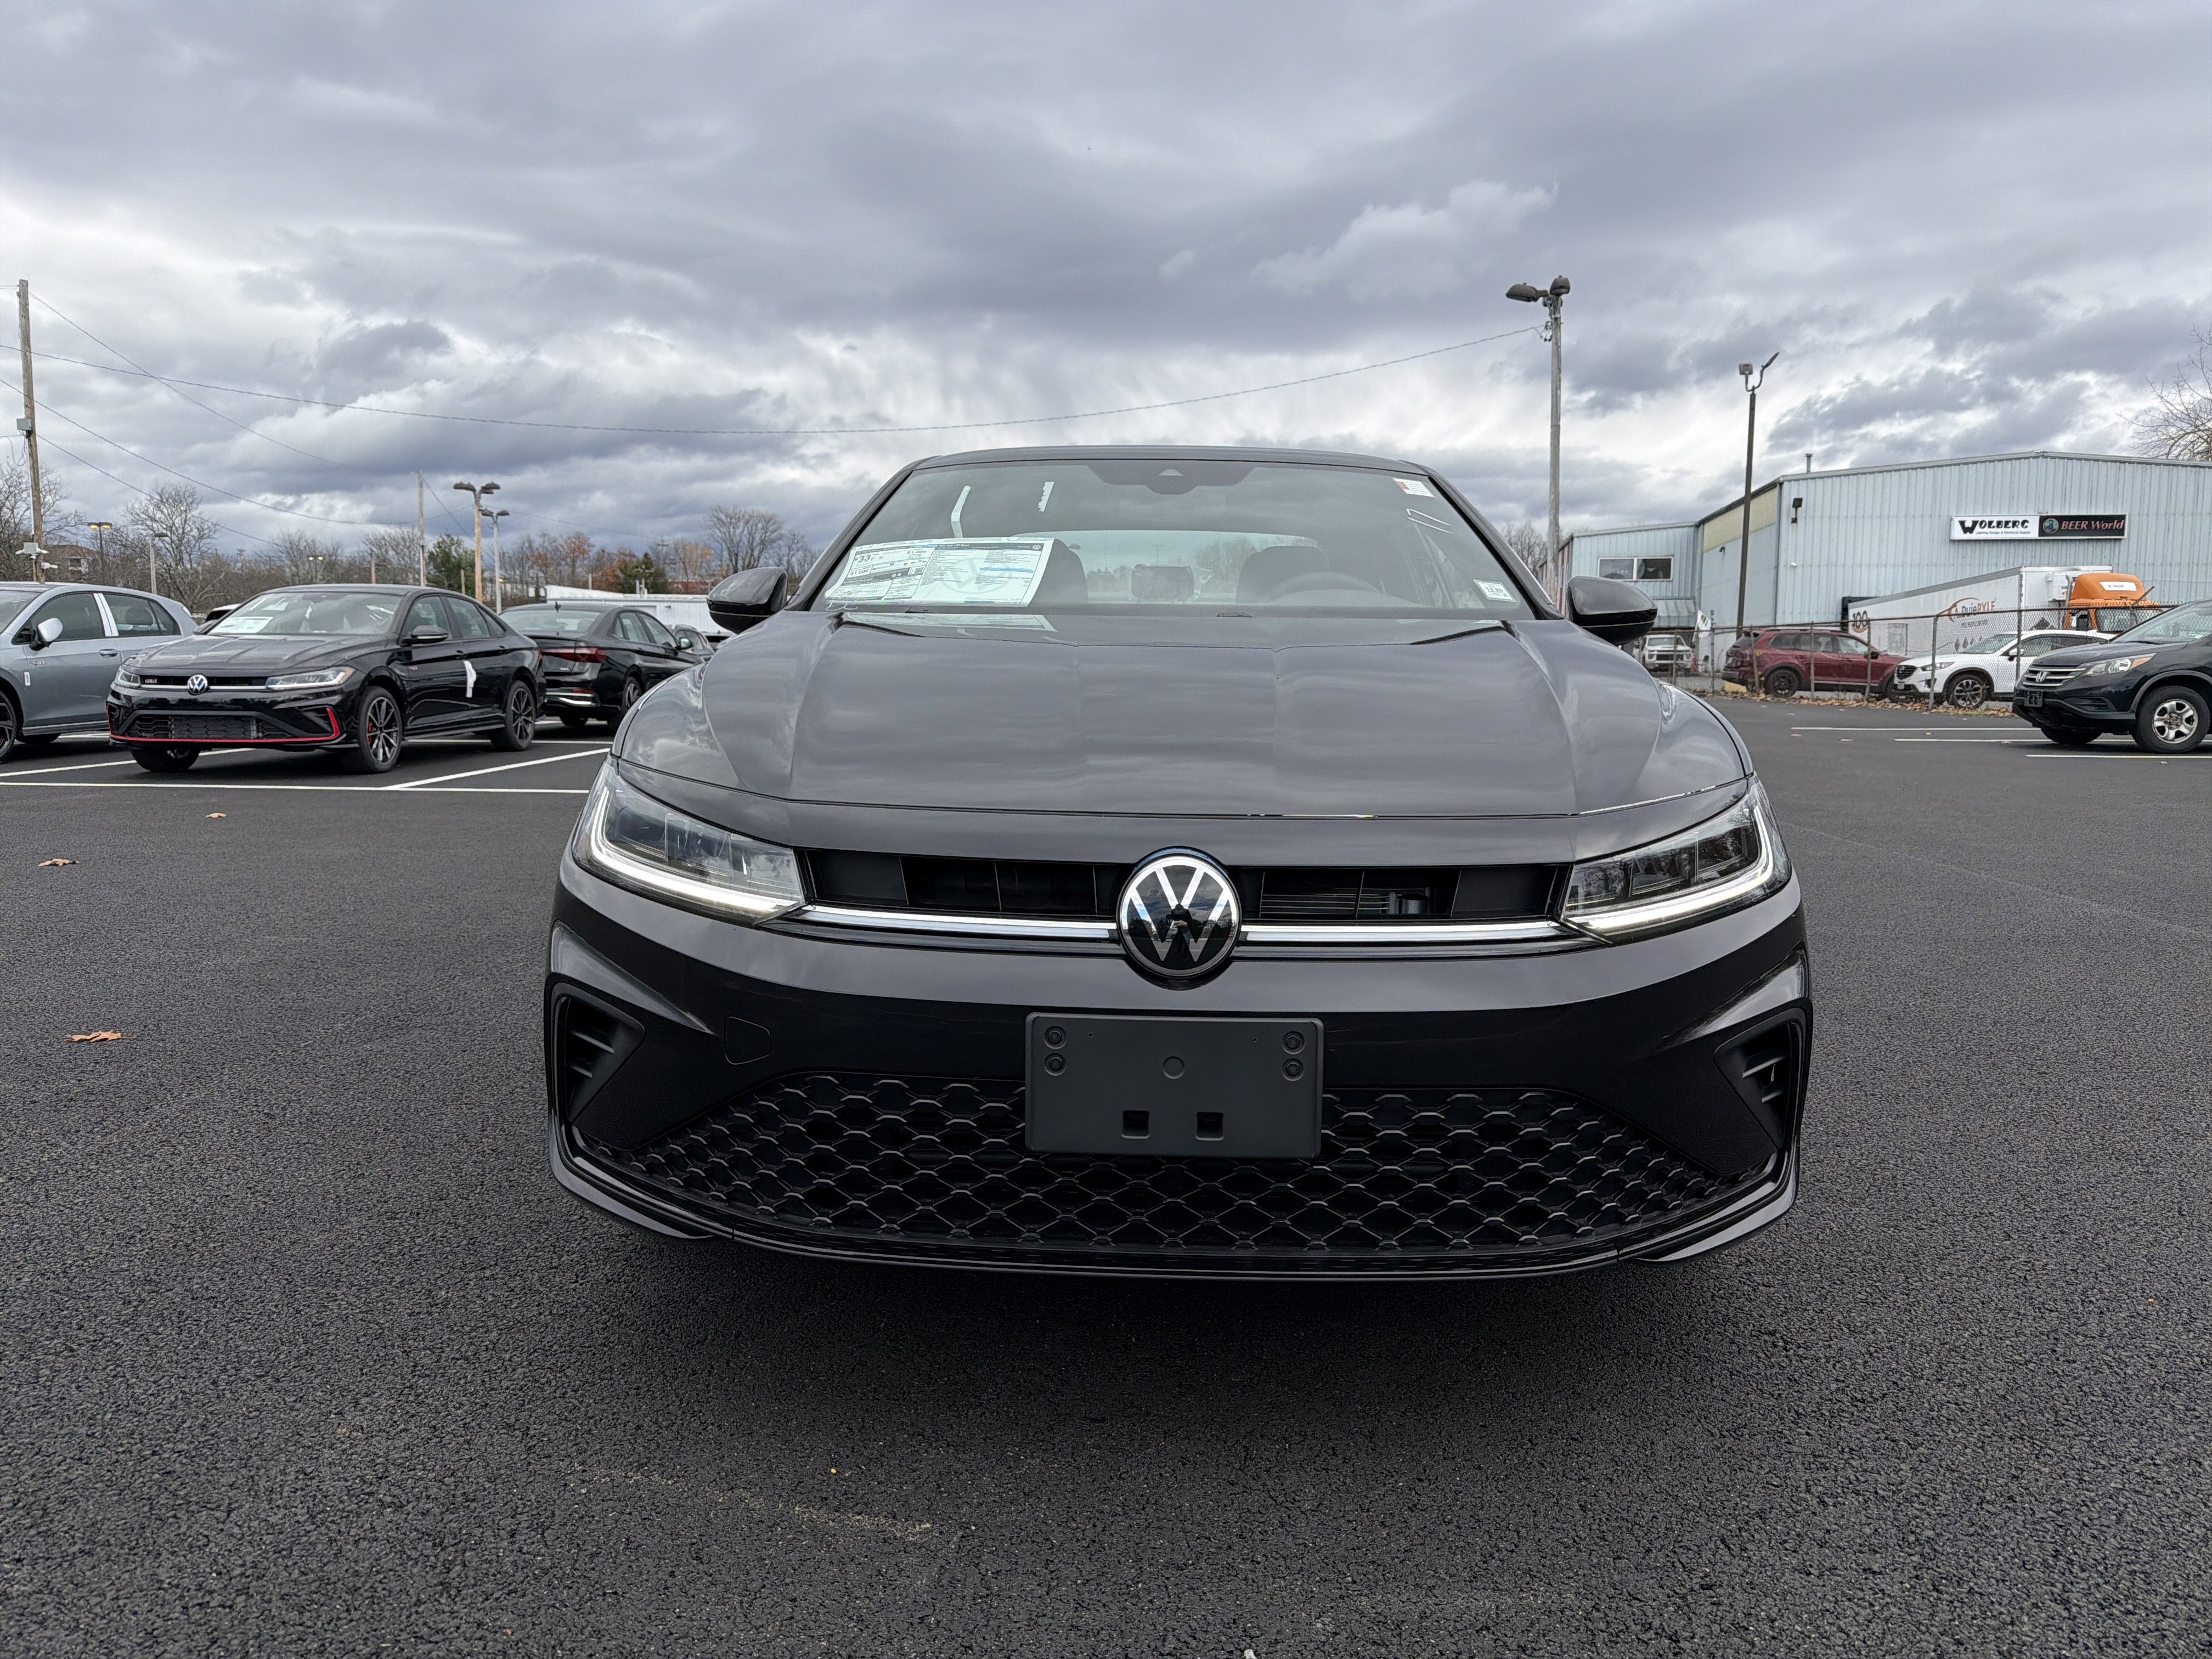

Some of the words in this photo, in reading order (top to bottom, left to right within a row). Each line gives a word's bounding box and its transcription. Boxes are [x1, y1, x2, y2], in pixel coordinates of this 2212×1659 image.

[2061, 521, 2089, 530] BEER
[2091, 520, 2125, 530] World
[1851, 610, 1868, 629] 100
